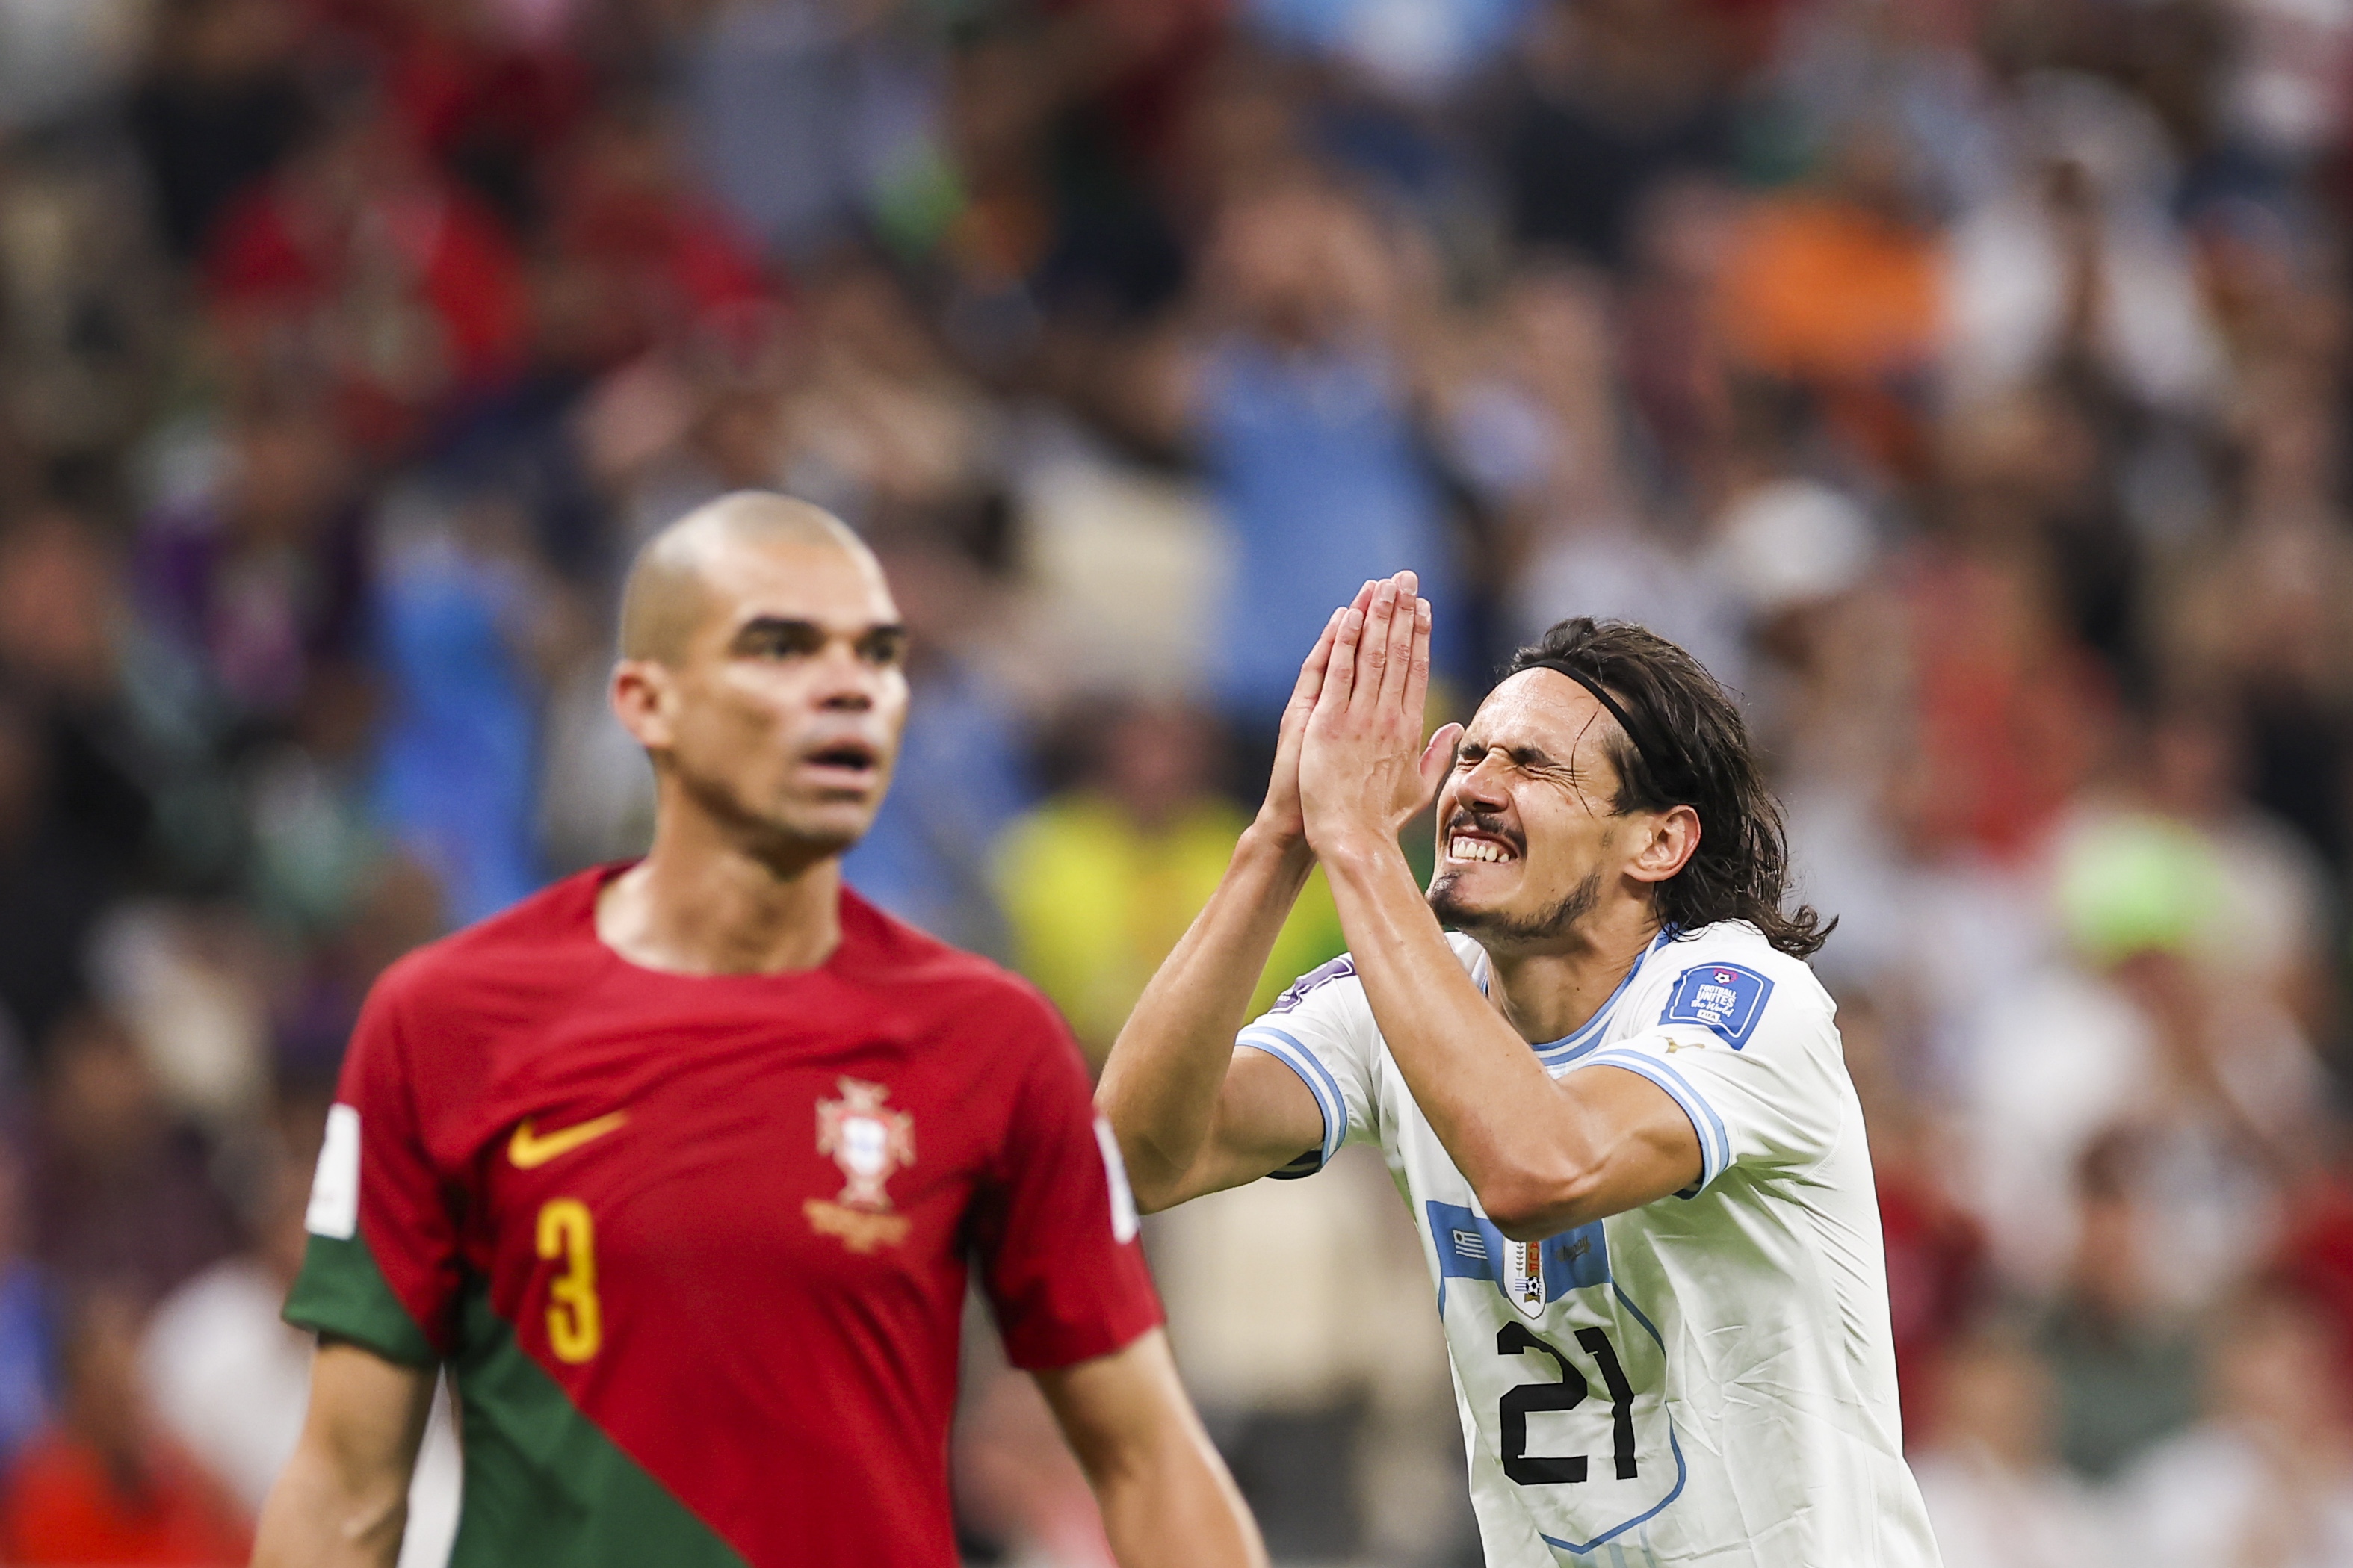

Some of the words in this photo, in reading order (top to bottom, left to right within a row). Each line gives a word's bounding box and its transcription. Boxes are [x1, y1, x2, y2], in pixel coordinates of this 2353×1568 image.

[1696, 991, 1735, 1008] UNITES
[1699, 984, 1737, 1000] FOOTBALL
[1700, 1011, 1718, 1020] FIFA
[1706, 1002, 1734, 1017] World
[537, 1197, 601, 1362] 3
[1497, 1321, 1638, 1485] 21
